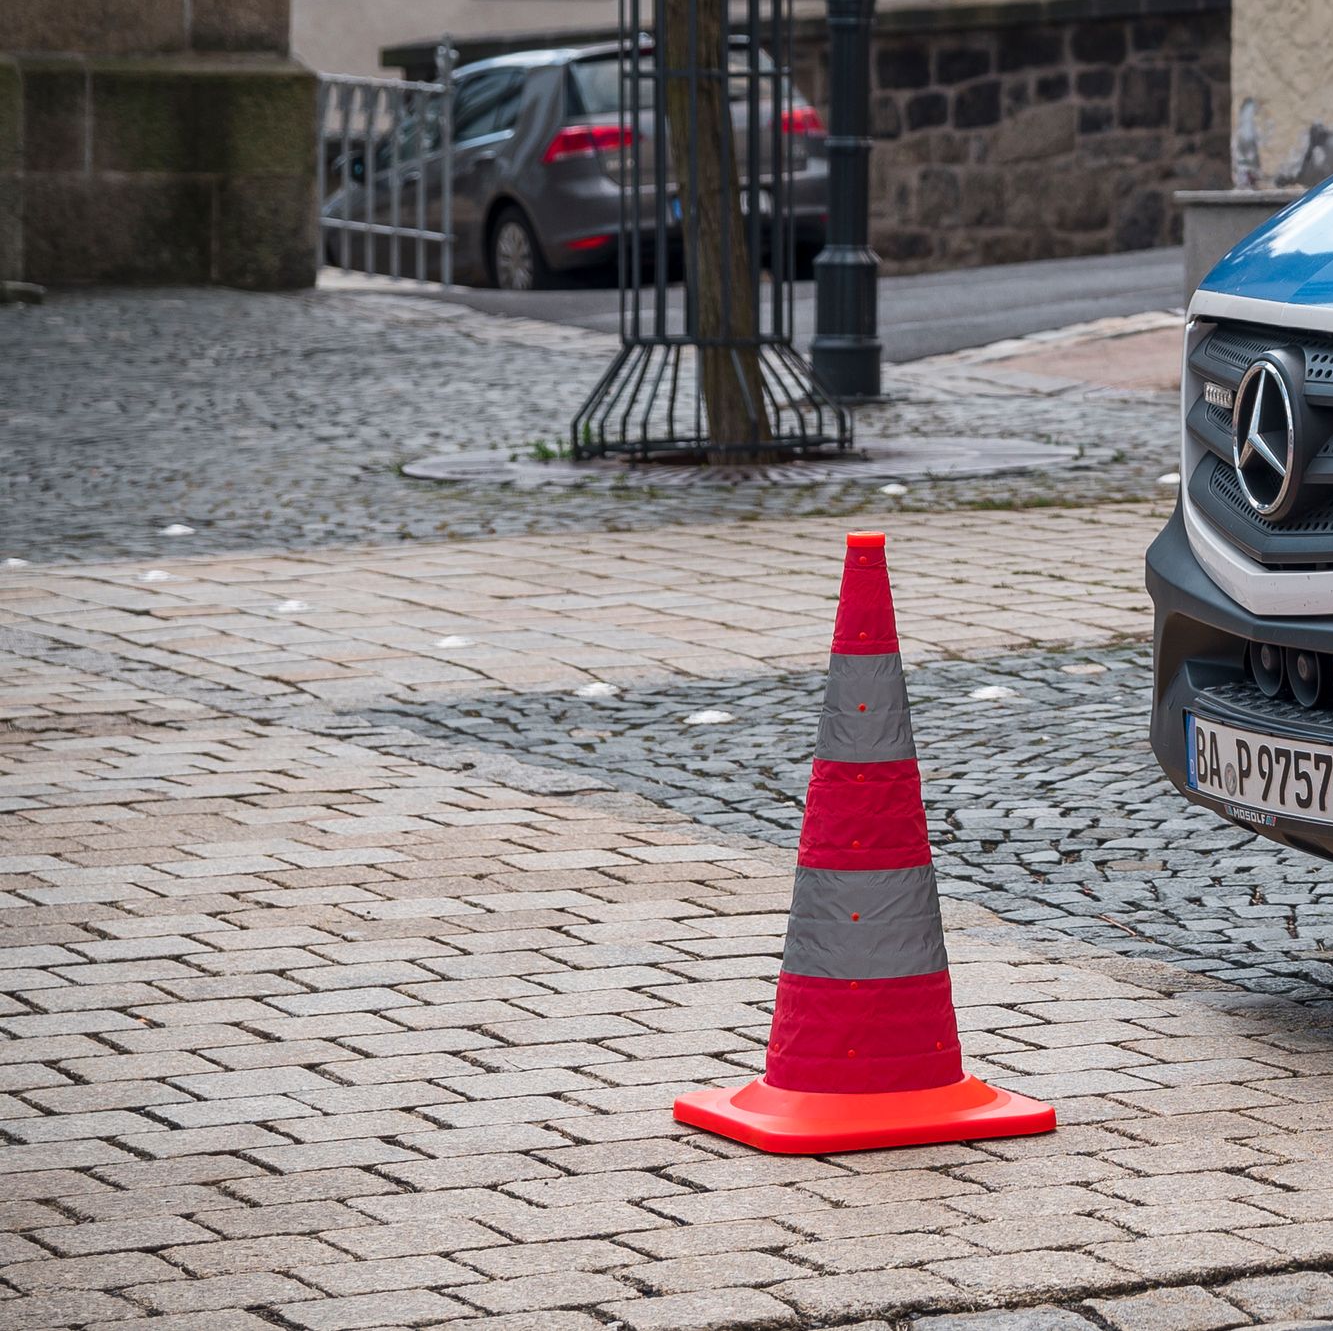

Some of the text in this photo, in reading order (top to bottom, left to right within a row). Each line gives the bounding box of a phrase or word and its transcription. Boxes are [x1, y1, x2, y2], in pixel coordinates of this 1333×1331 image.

[1196, 726, 1333, 811] BA P 9757
[1232, 806, 1266, 826] MOSOLF
